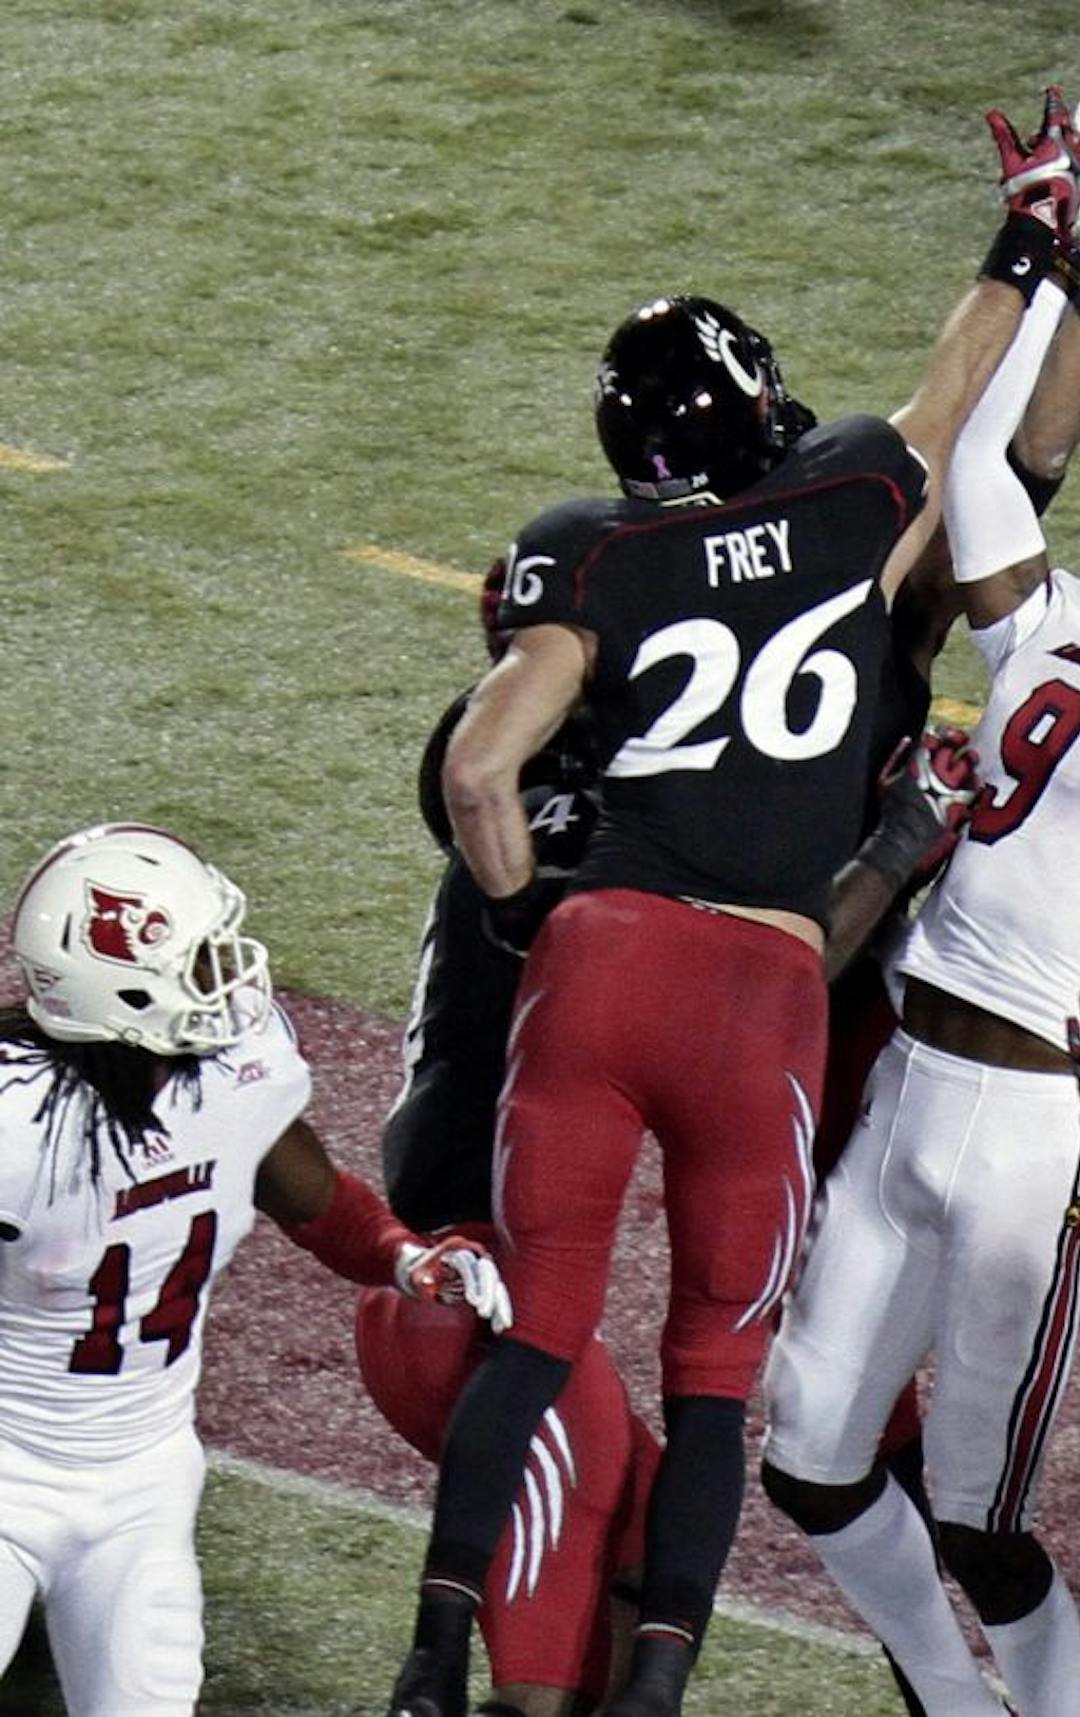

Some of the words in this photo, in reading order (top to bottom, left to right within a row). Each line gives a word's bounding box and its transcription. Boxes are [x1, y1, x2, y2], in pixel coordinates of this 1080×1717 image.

[704, 520, 792, 587] FREY
[604, 578, 874, 778] 26
[68, 1208, 218, 1375] 14
